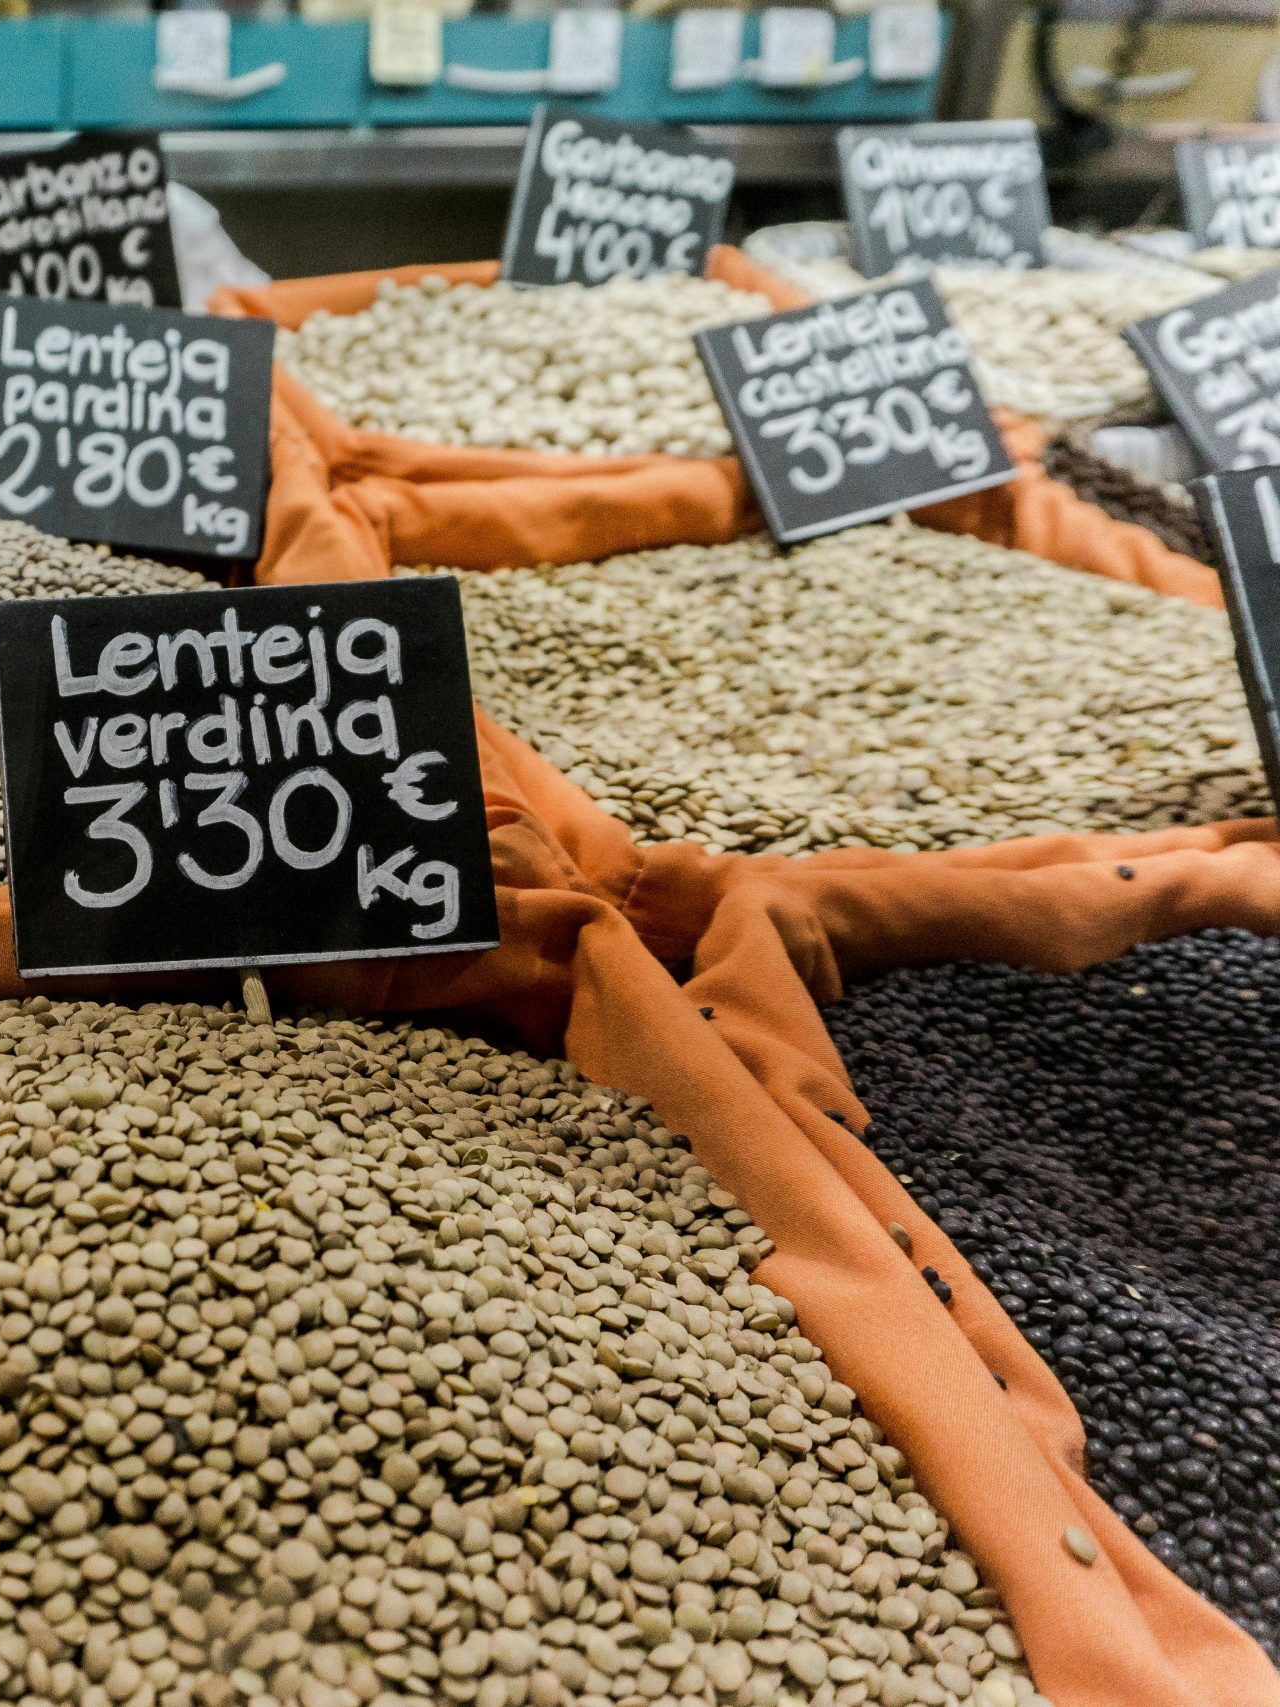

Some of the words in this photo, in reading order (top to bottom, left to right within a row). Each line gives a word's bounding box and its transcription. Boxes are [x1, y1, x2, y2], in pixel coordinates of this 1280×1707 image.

[0, 306, 230, 395] Lenteja
[731, 289, 930, 374] Lenteja
[2, 374, 227, 441] pardina
[759, 386, 933, 495] 3'30
[187, 445, 238, 492] €
[51, 605, 403, 709] Lenteja
[54, 694, 401, 778] verdina
[63, 766, 353, 909] 3'30
[381, 750, 459, 821] €
